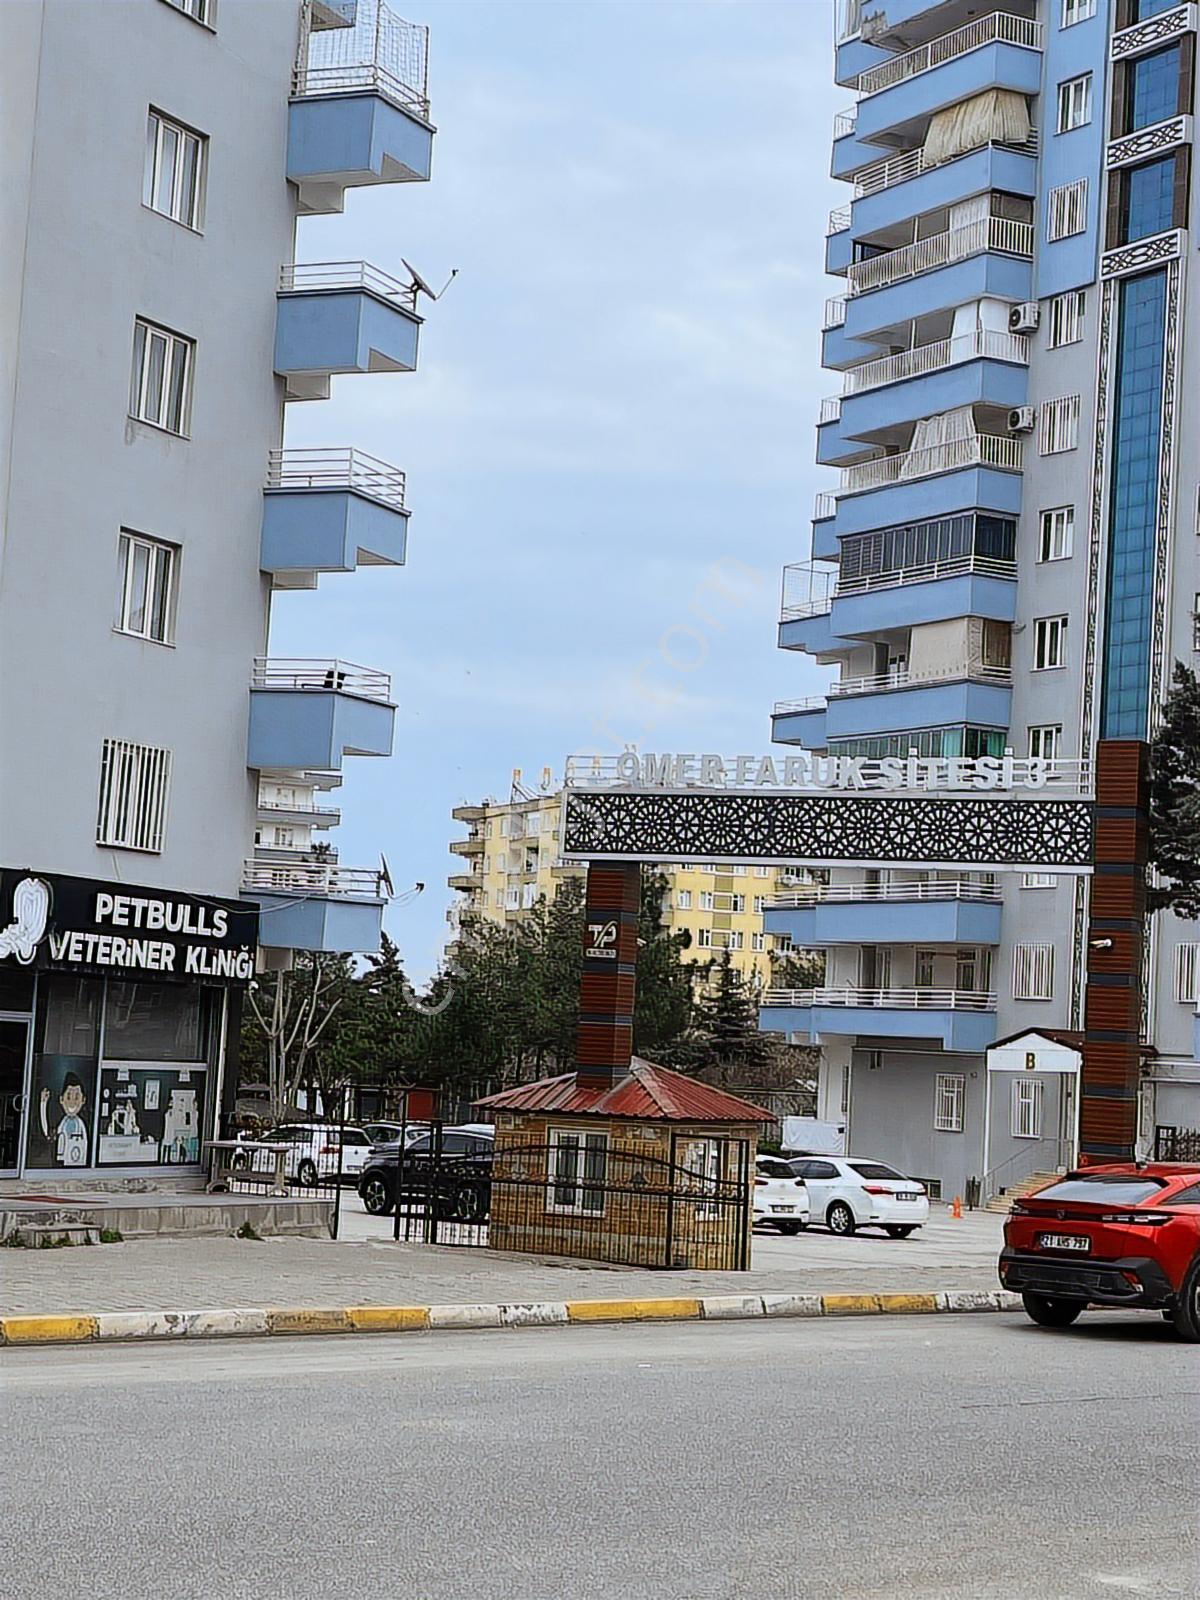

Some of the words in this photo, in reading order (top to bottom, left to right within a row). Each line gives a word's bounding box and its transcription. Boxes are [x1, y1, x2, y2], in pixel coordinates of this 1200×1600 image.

[616, 743, 726, 788] ÖMER
[735, 755, 868, 789] FARUK
[879, 746, 1015, 791] SİTESİ
[1023, 756, 1048, 791] 3
[95, 892, 229, 938] PETBULLS
[49, 930, 177, 972] VETERİNER
[184, 944, 255, 980] KLİNİĞİ
[1025, 1051, 1036, 1071] B
